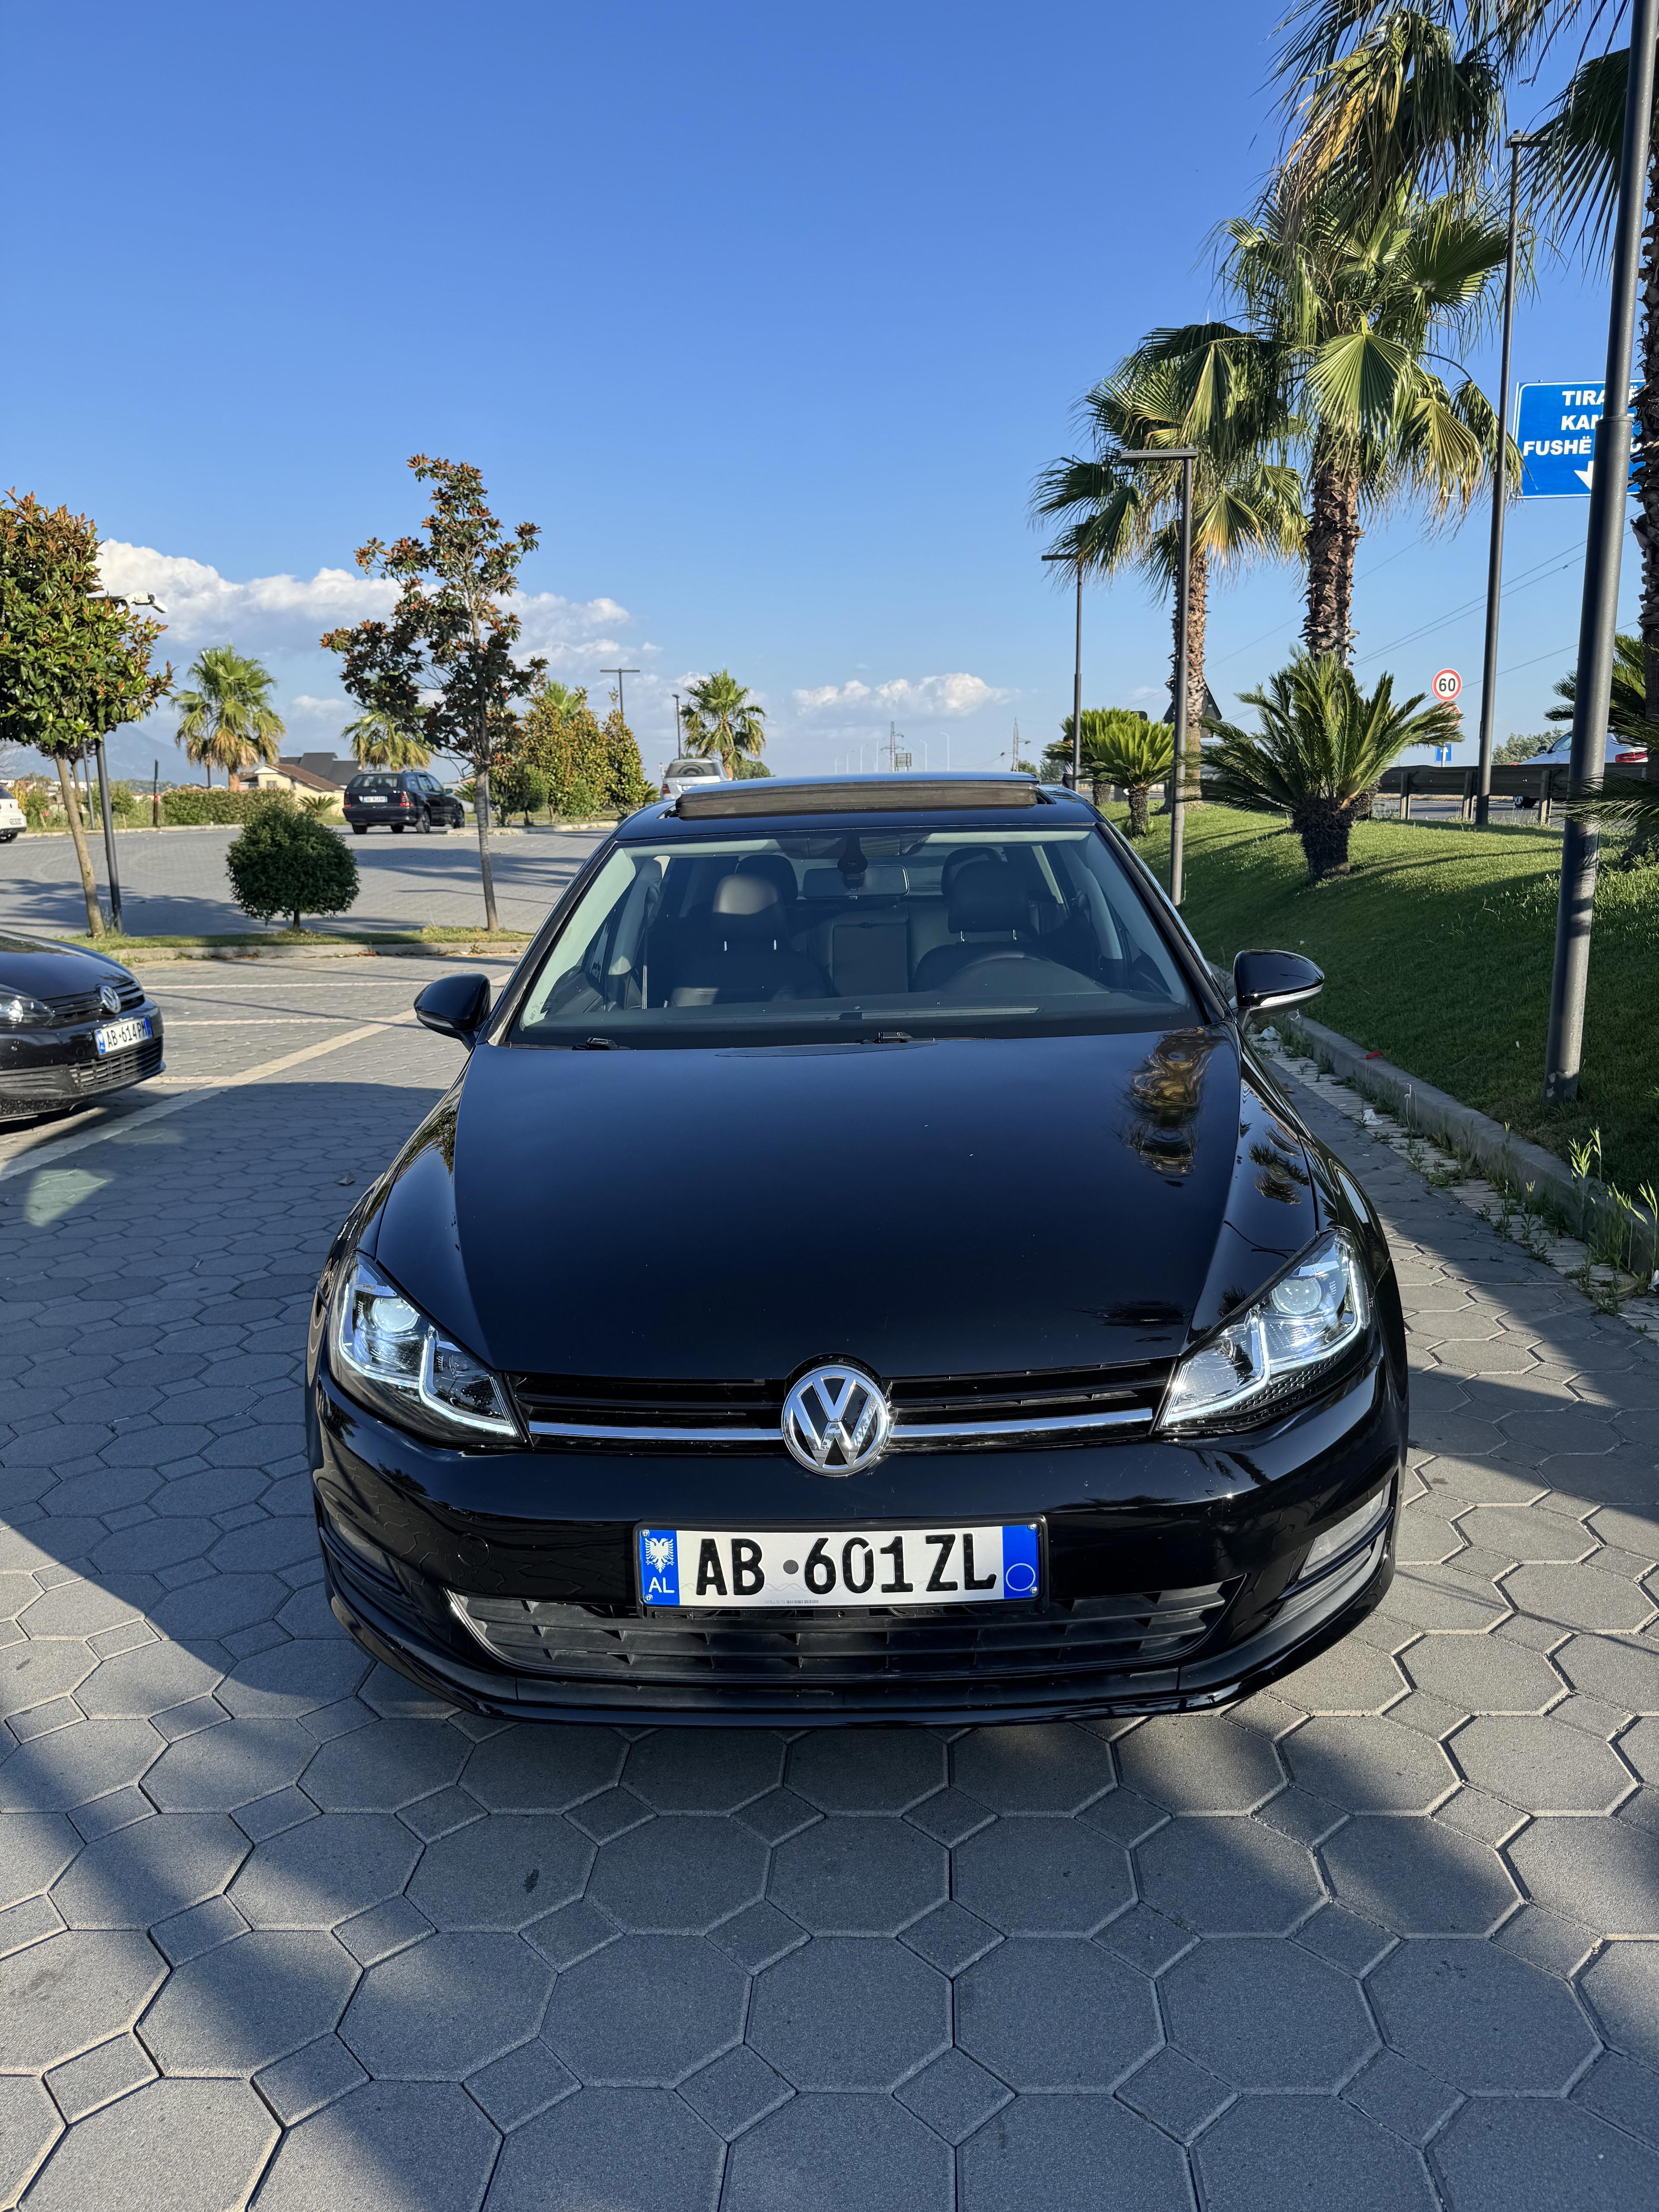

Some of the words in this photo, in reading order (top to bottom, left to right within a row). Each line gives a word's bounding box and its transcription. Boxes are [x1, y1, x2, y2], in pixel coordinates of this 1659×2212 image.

[1523, 436, 1592, 456] FUSHË
[1439, 678, 1456, 692] 60
[107, 1030, 118, 1048] AB
[696, 1538, 765, 1595] AB
[648, 1576, 675, 1593] AL
